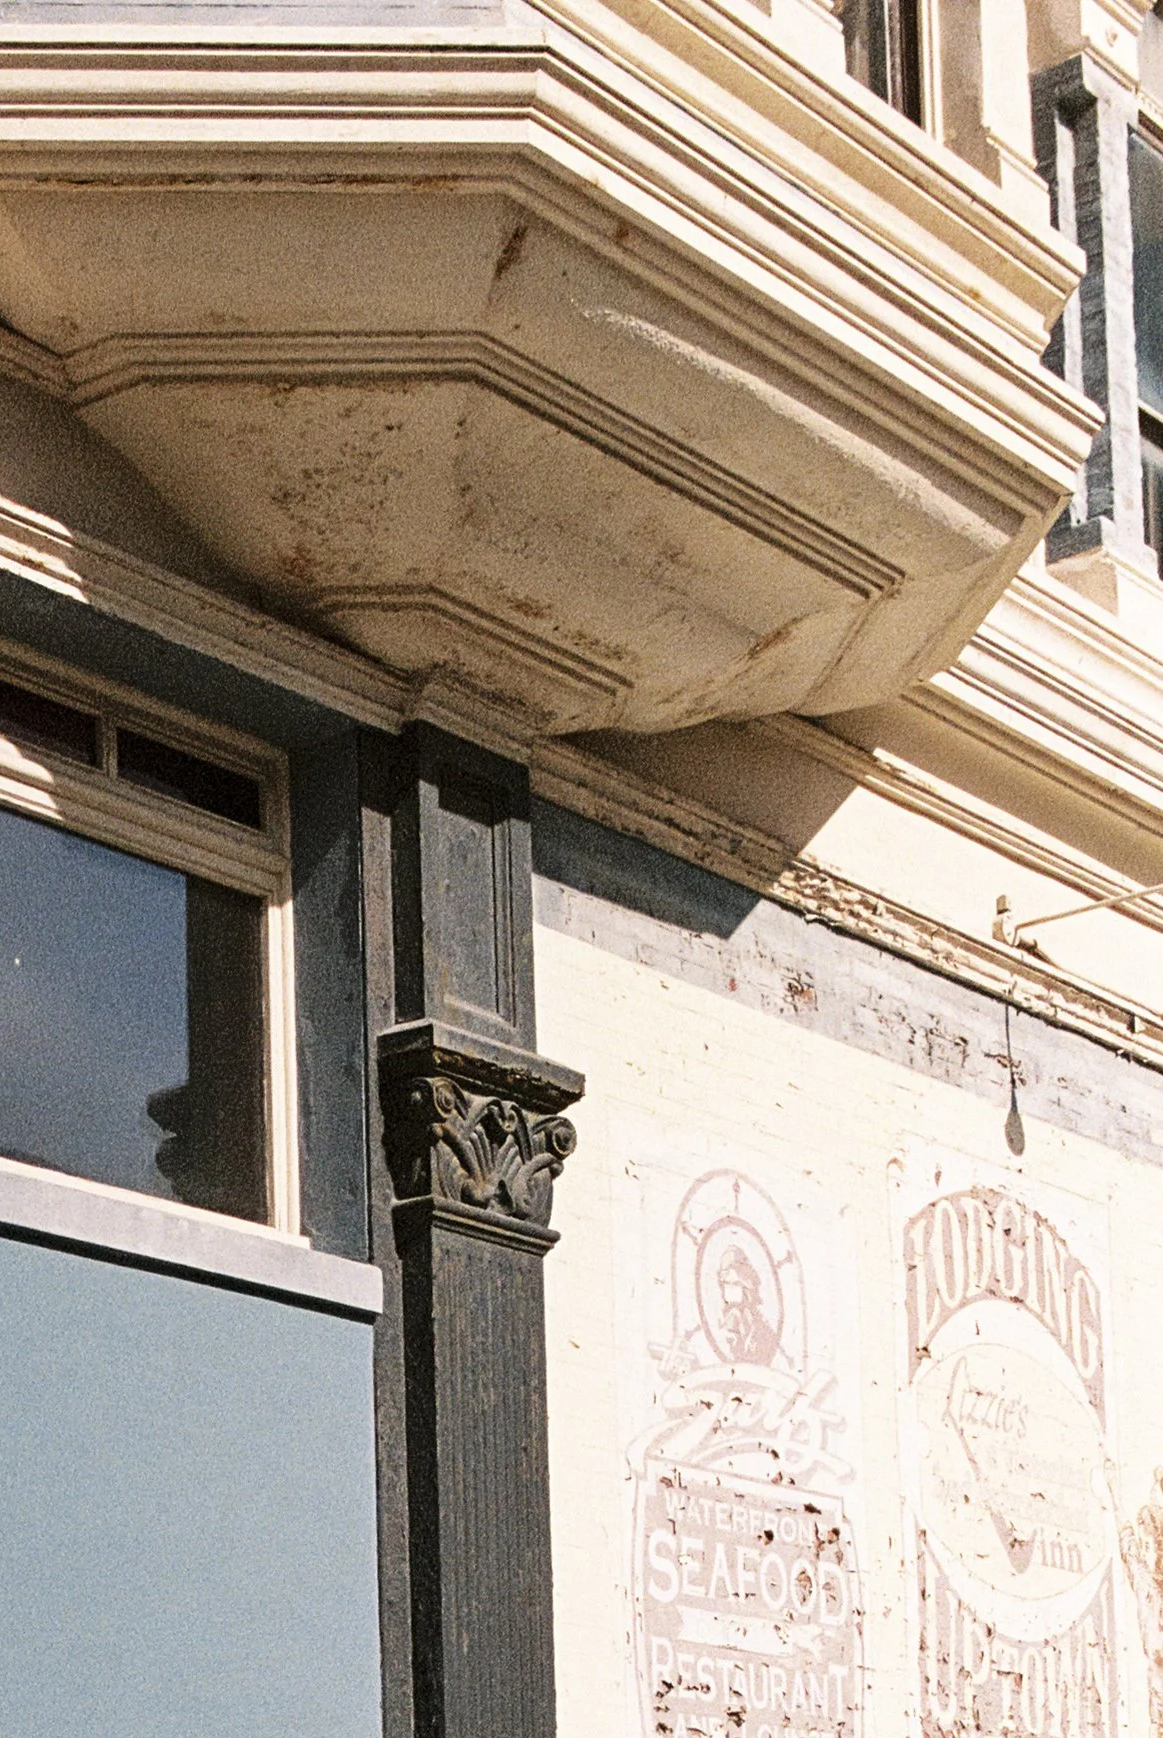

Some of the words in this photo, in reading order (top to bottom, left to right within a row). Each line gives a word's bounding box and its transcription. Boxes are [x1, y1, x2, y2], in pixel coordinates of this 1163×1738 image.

[908, 1195, 1101, 1379] LODGING
[941, 1355, 1029, 1440] Lizzie's
[664, 1489, 829, 1546] WATERFRONT
[1040, 1527, 1084, 1574] inn
[648, 1530, 848, 1626] SEAFOOD
[650, 1636, 849, 1719] RESTAURANT
